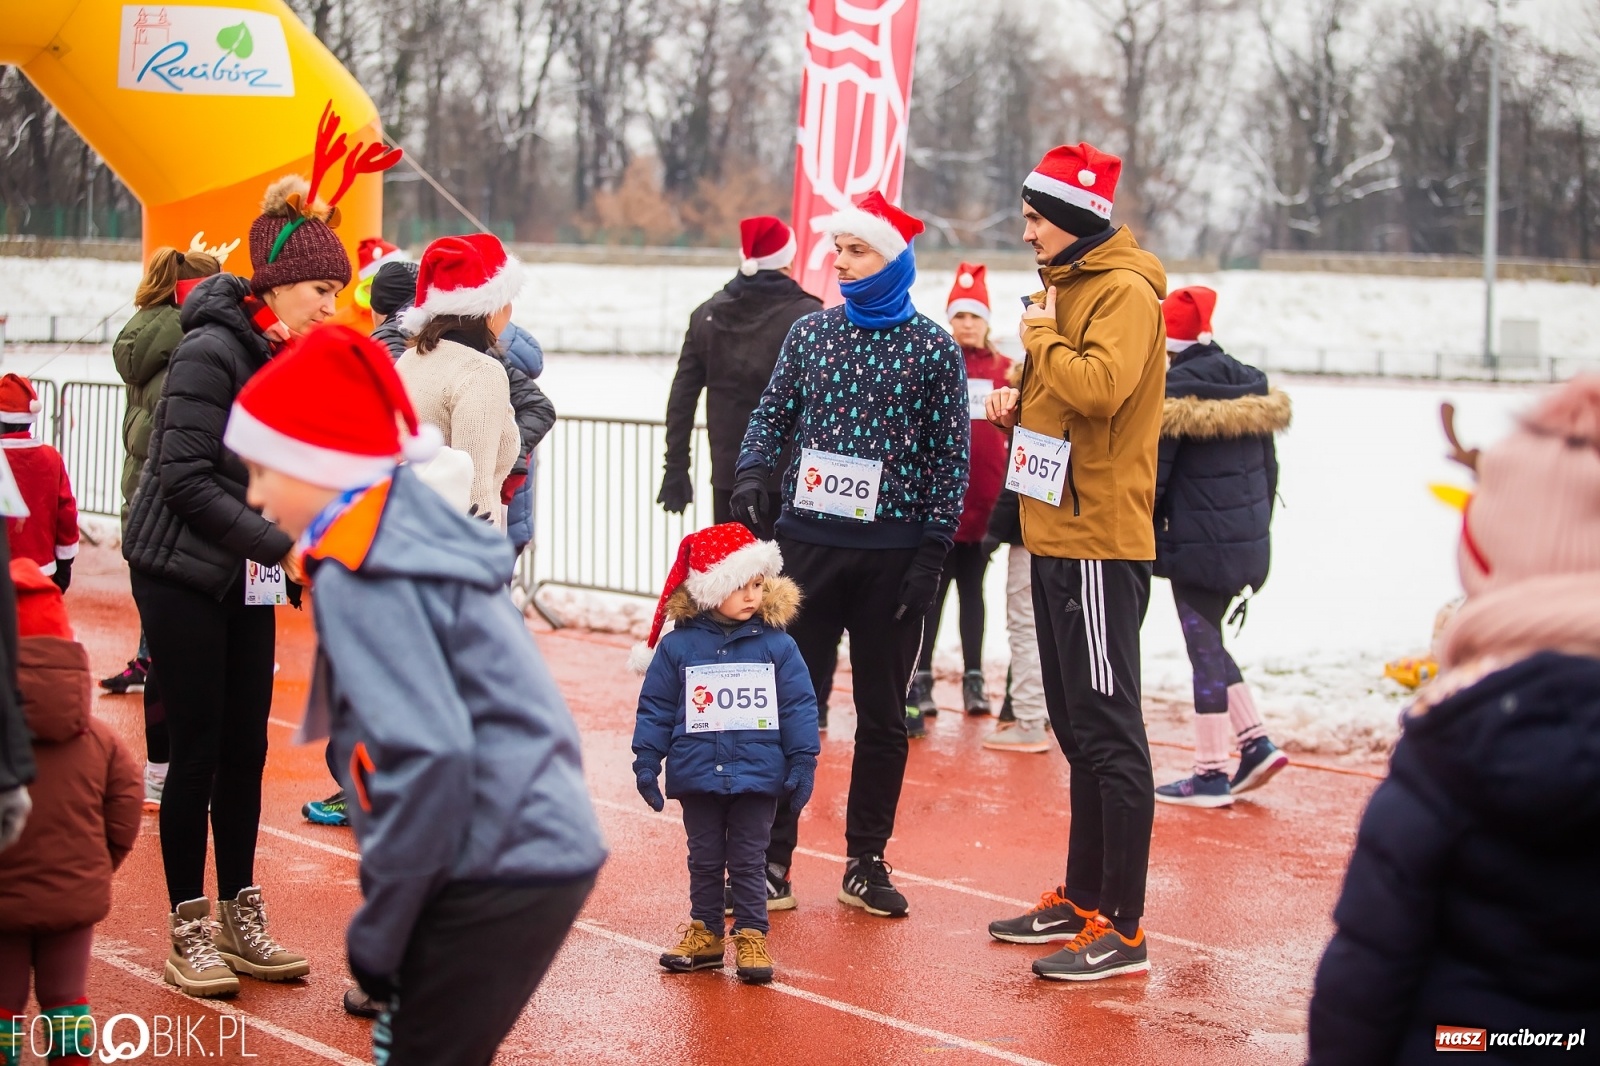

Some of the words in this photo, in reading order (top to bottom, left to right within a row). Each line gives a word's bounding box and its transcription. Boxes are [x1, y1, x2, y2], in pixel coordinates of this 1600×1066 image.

[1027, 454, 1062, 482] 057
[824, 474, 870, 499] 026
[260, 562, 281, 583] 048
[717, 687, 768, 710] 055
